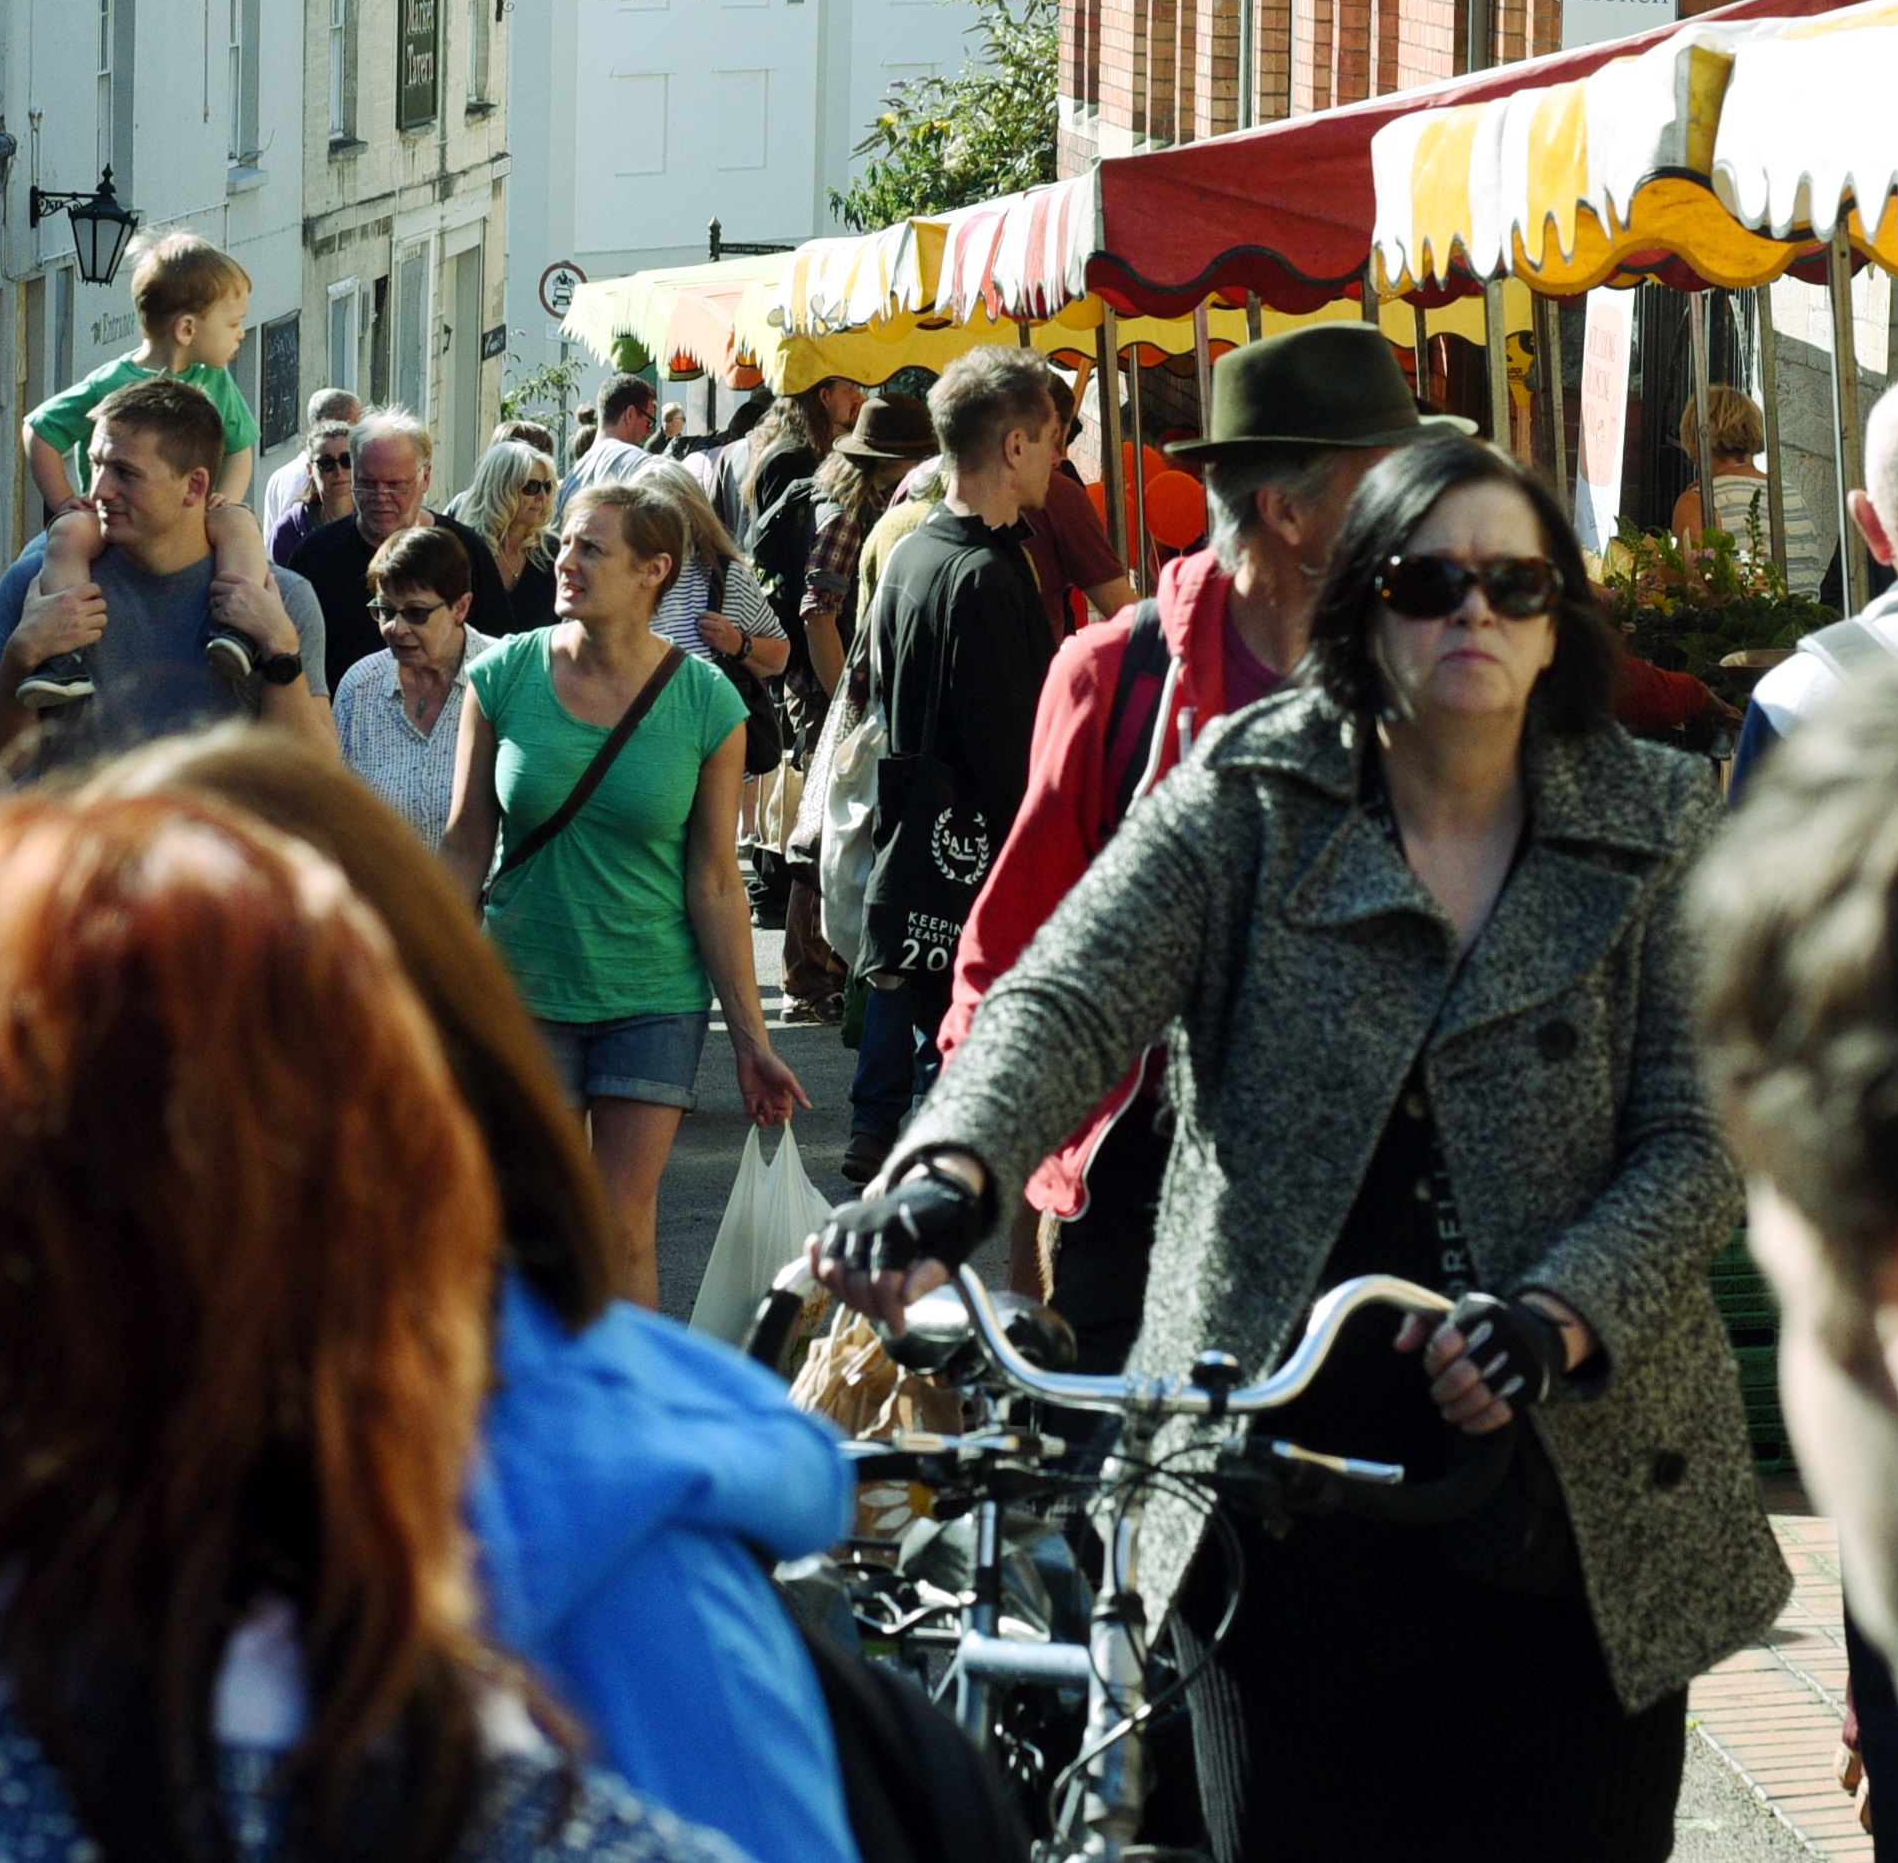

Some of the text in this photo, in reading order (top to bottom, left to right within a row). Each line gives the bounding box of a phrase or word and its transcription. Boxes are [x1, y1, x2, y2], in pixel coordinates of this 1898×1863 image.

[406, 43, 434, 86] Tavern
[941, 829, 986, 854] SALT
[907, 925, 955, 947] YEASTY
[898, 938, 949, 972] 20
